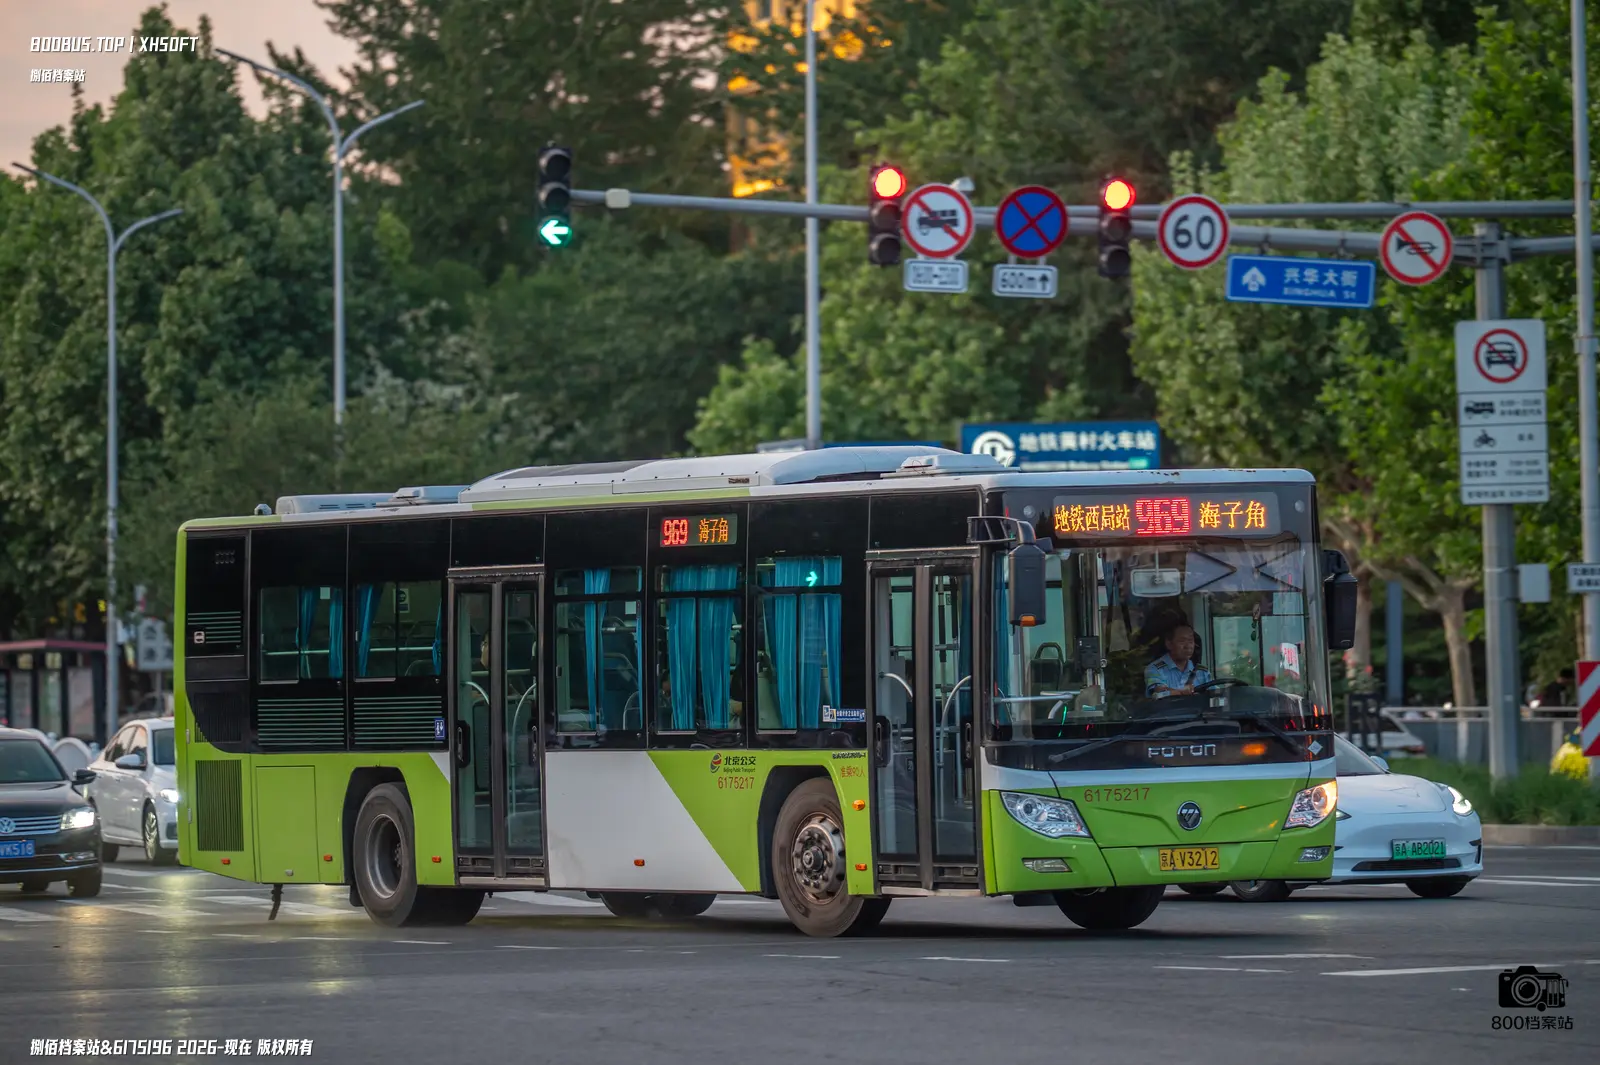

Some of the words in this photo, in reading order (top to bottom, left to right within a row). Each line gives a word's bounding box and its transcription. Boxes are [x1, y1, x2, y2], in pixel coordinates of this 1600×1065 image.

[1173, 214, 1216, 250] 60
[1283, 267, 1358, 288] 兴华大街
[1054, 504, 1131, 532] 地铁西局站
[1136, 499, 1190, 534] 969
[1199, 500, 1267, 529] 海子角
[662, 518, 689, 546] 969
[699, 517, 729, 543] 海子角
[1148, 743, 1217, 758] FOTON
[724, 755, 757, 766] 北京公交
[718, 776, 755, 790] 6175217
[1084, 787, 1150, 803] 6175217
